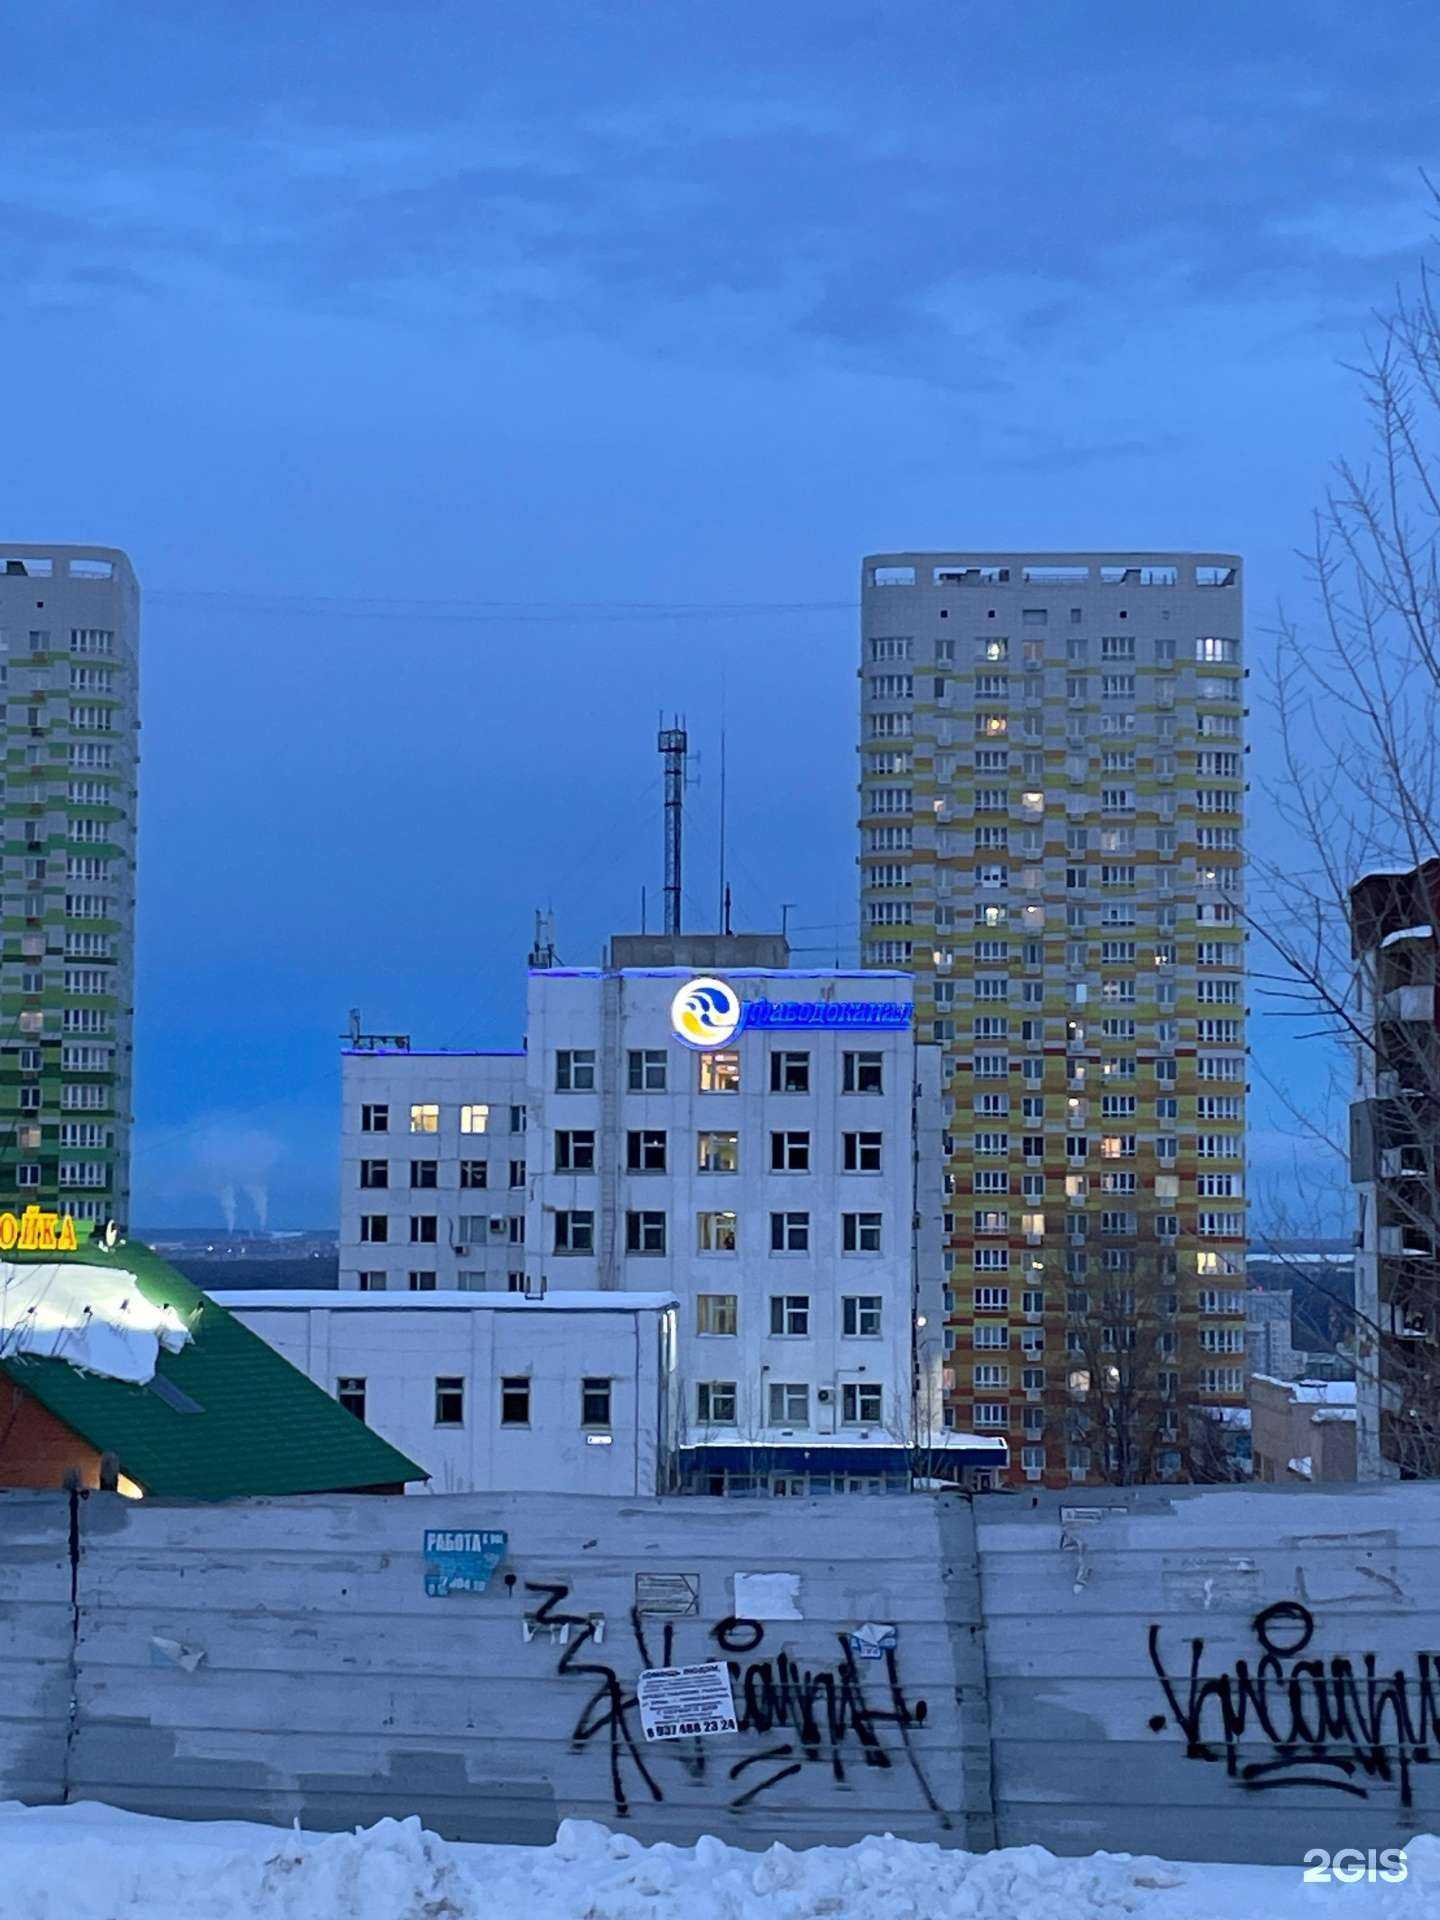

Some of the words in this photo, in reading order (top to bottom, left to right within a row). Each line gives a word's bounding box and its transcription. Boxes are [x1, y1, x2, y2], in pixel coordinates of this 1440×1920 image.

[427, 1533, 482, 1552] РАБОТА
[704, 1721, 719, 1732] 23
[721, 1719, 736, 1730] 24
